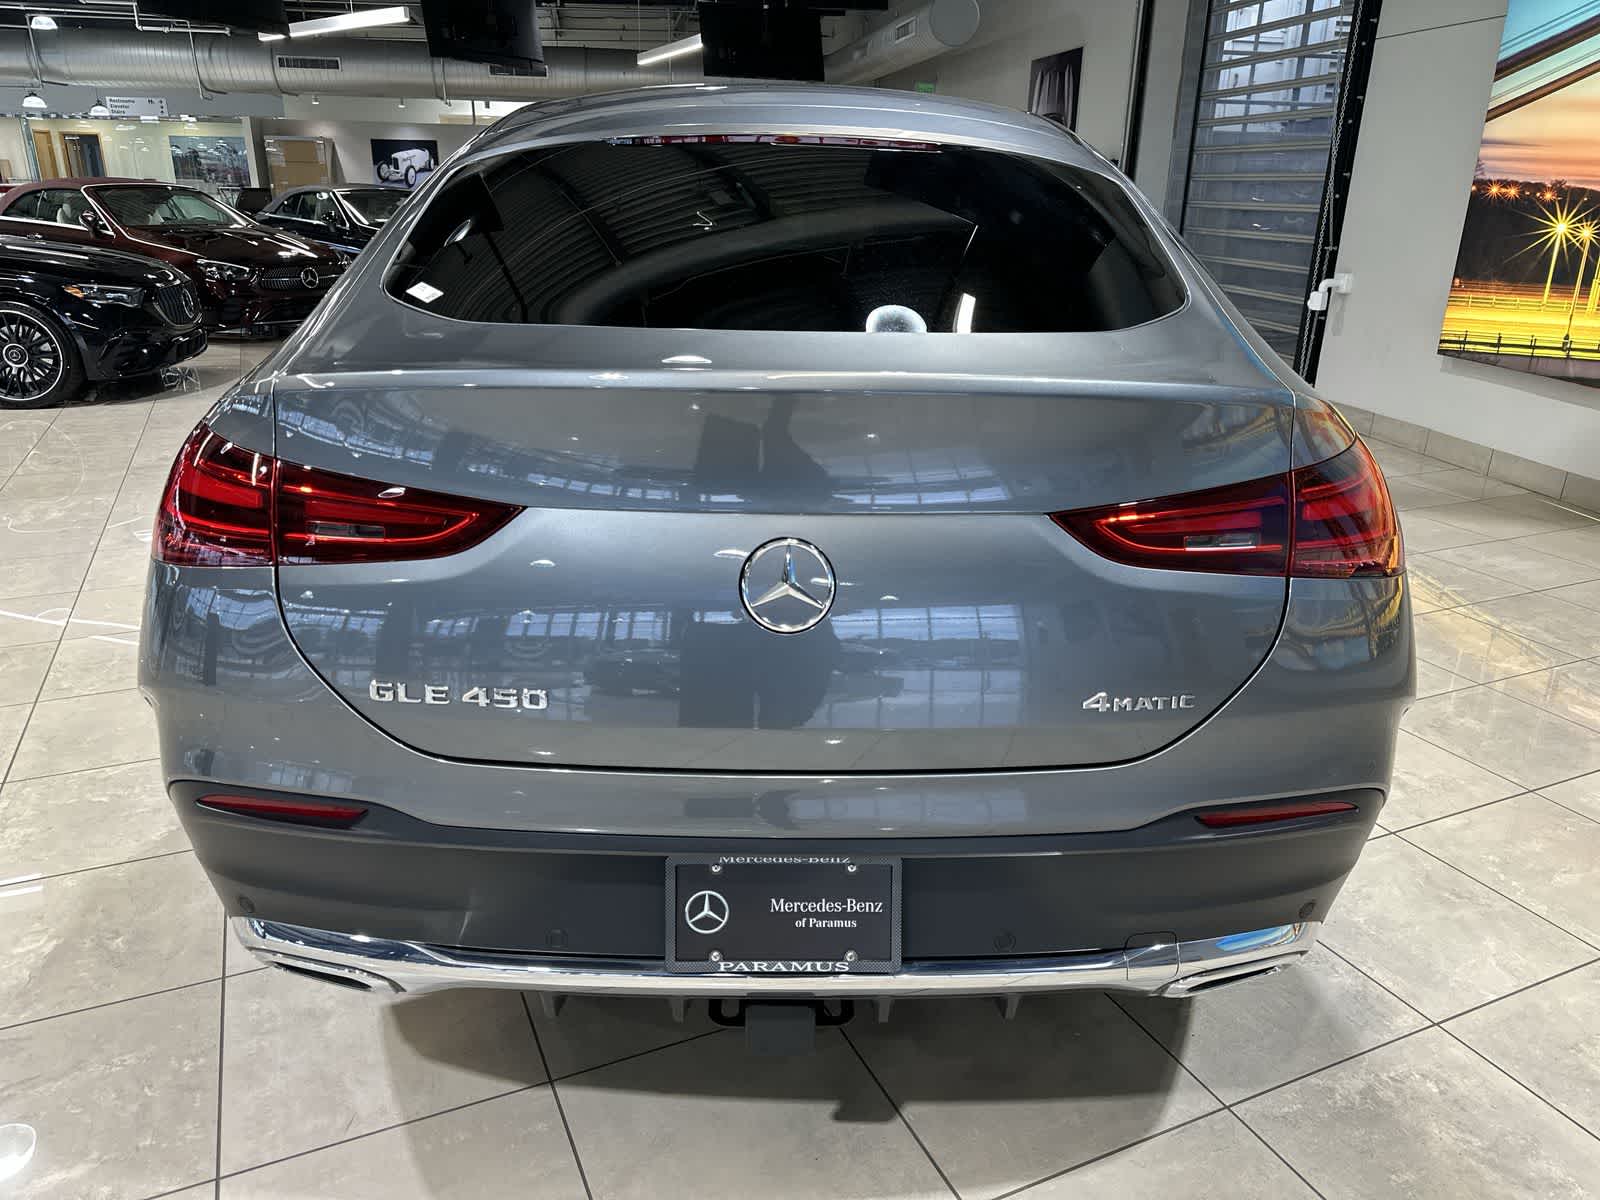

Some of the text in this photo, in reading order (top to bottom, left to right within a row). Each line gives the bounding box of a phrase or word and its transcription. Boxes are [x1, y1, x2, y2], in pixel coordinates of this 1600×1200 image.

[369, 679, 548, 709] GLE 450
[1082, 691, 1195, 712] 4MATIC
[770, 898, 883, 913] Mercedes-Benz
[795, 918, 857, 928] of Paramus
[718, 961, 850, 972] PARAMUS
